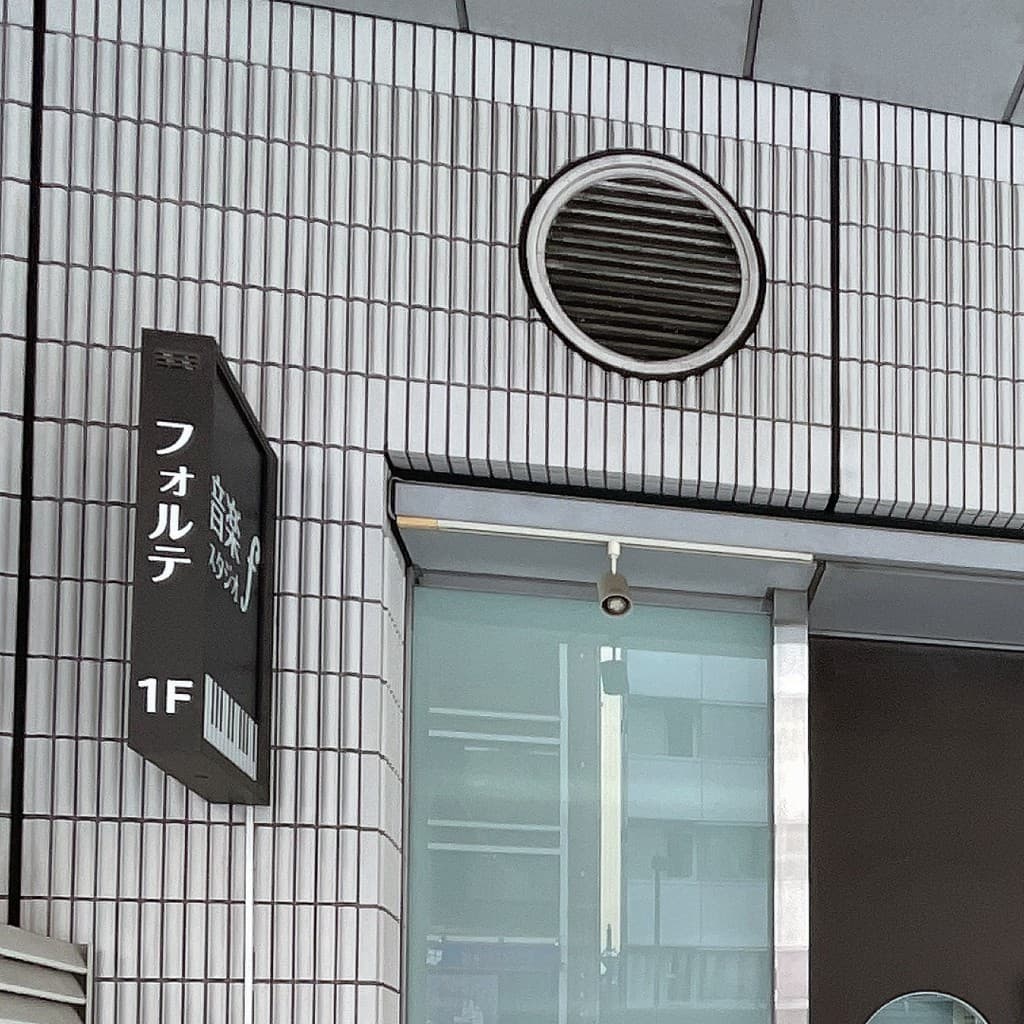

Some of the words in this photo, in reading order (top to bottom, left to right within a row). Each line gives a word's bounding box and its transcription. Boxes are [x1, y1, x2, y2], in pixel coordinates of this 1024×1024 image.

[147, 421, 196, 583] フォルテ
[209, 474, 242, 565] 音楽
[137, 677, 195, 714] 1F
